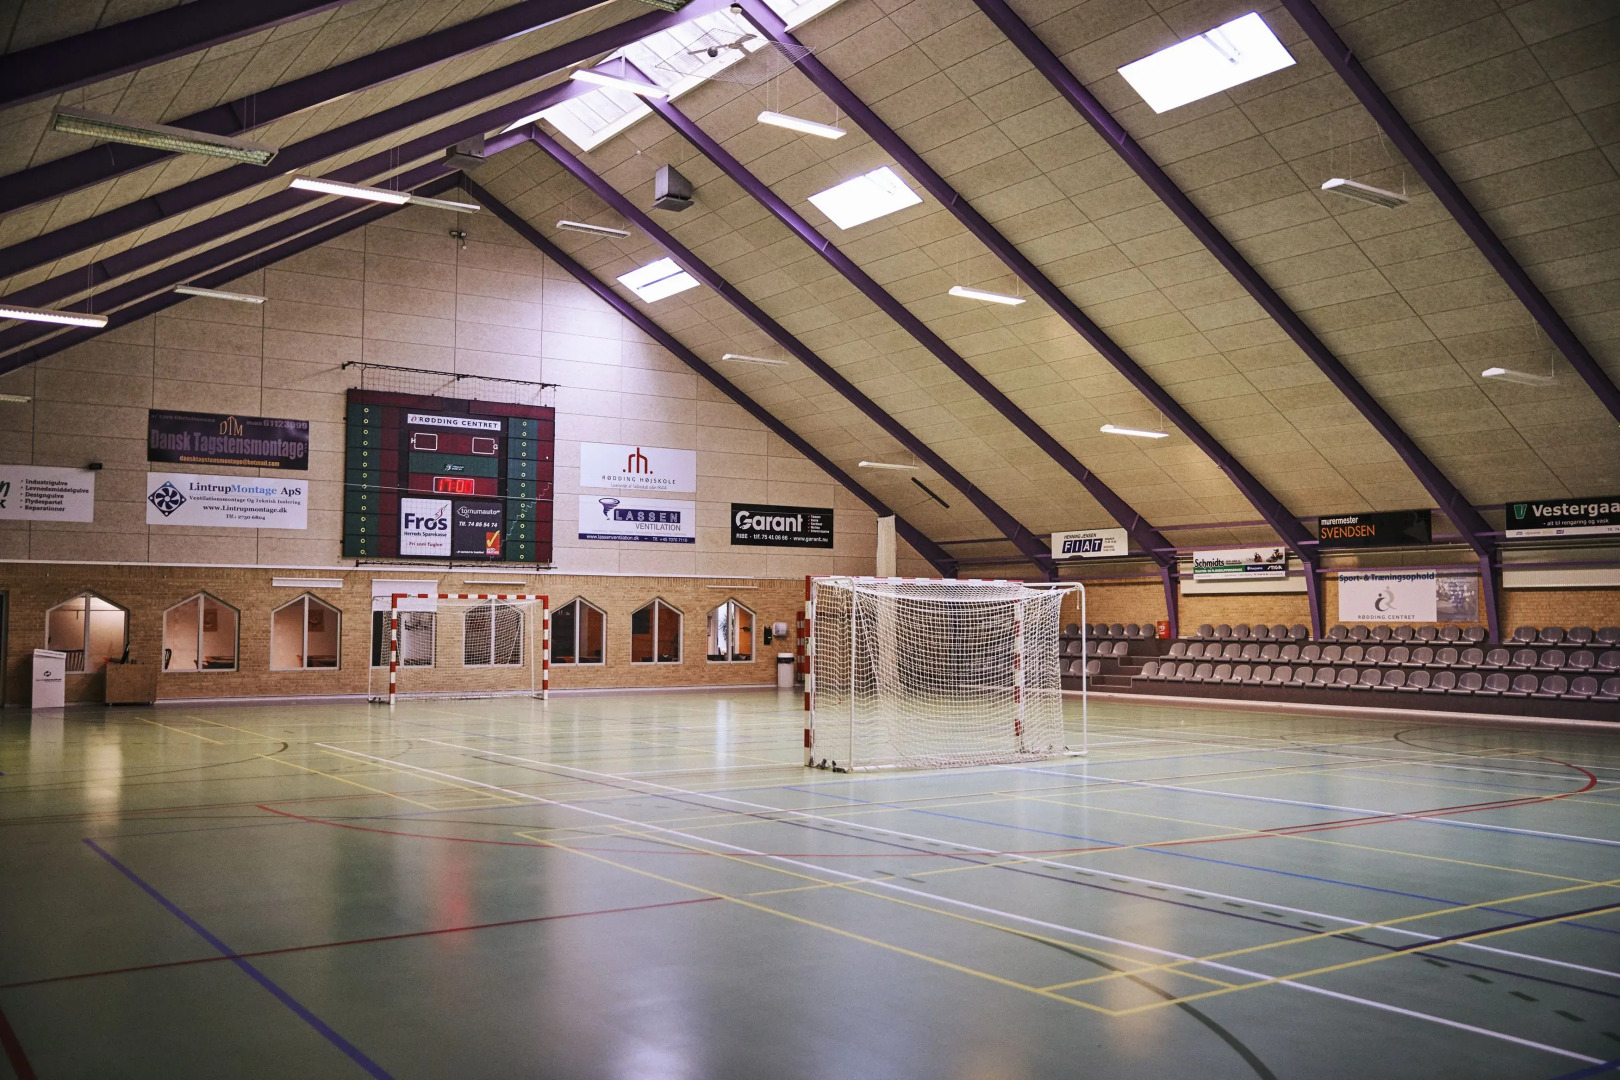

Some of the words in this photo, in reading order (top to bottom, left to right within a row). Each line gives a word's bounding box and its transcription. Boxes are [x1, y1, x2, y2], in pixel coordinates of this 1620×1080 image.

[219, 416, 243, 436] DTM
[419, 416, 458, 425] RØDDING
[151, 429, 191, 451] Dansk
[193, 432, 304, 460] Tagstensmontage
[189, 482, 277, 496] LintrupMontage
[281, 487, 301, 497] ApS
[438, 478, 473, 493] 17:00
[615, 510, 678, 522] LASSEN
[736, 511, 803, 532] Garant
[1321, 516, 1358, 525] murermester
[635, 523, 681, 531] VENTILATION
[1321, 524, 1376, 539] SVENDSEN
[1064, 540, 1101, 552] FIAT
[1195, 558, 1224, 568] Schmidts
[1339, 575, 1363, 583] Sport-
[1371, 572, 1434, 582] Træningsophold
